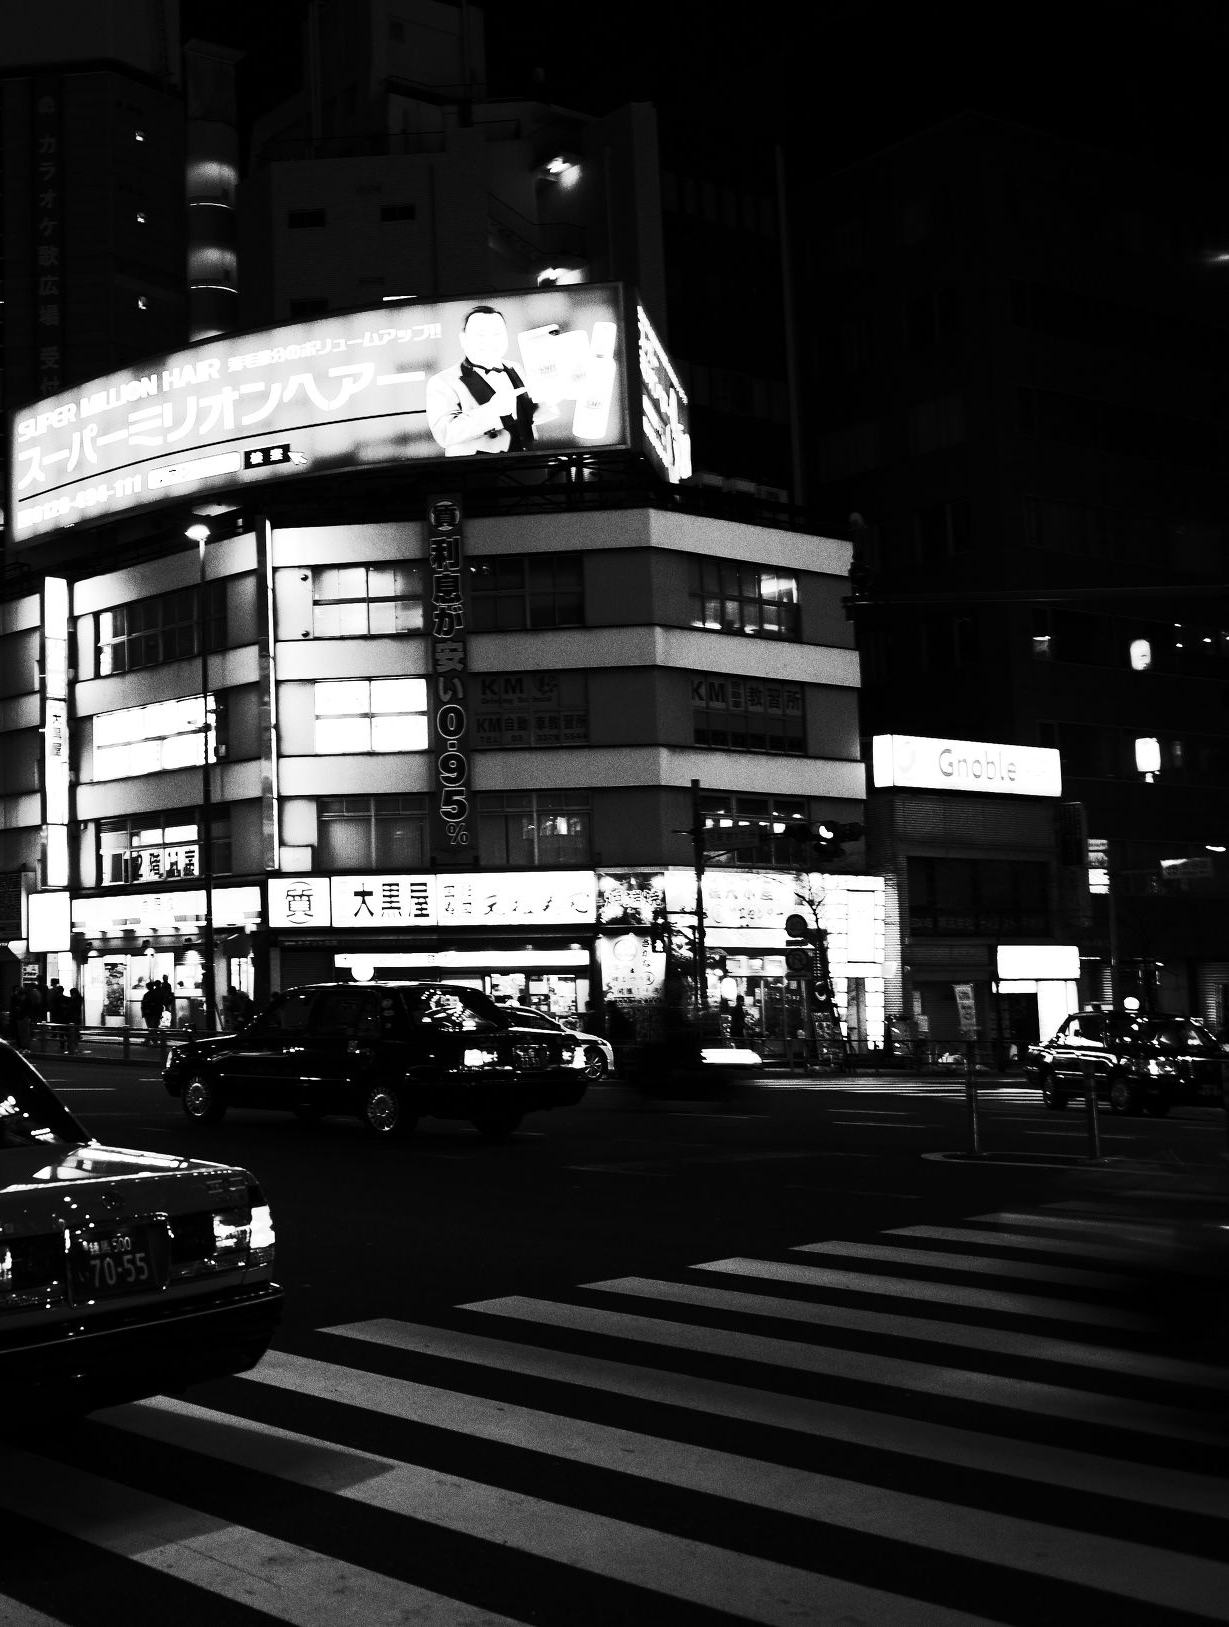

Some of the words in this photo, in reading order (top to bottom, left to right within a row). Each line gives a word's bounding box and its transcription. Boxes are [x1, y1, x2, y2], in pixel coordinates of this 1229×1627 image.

[18, 403, 77, 442] SUPER
[80, 374, 158, 418] MILLION
[162, 358, 221, 391] HAIR
[18, 362, 426, 490] スーパーミリオンヘアー
[481, 677, 524, 695] KM
[938, 748, 1018, 782] Gnoble
[285, 881, 314, 924] 質
[354, 882, 430, 918] 大黒屋
[112, 1236, 131, 1253] 500
[90, 1253, 148, 1288] 70-55
